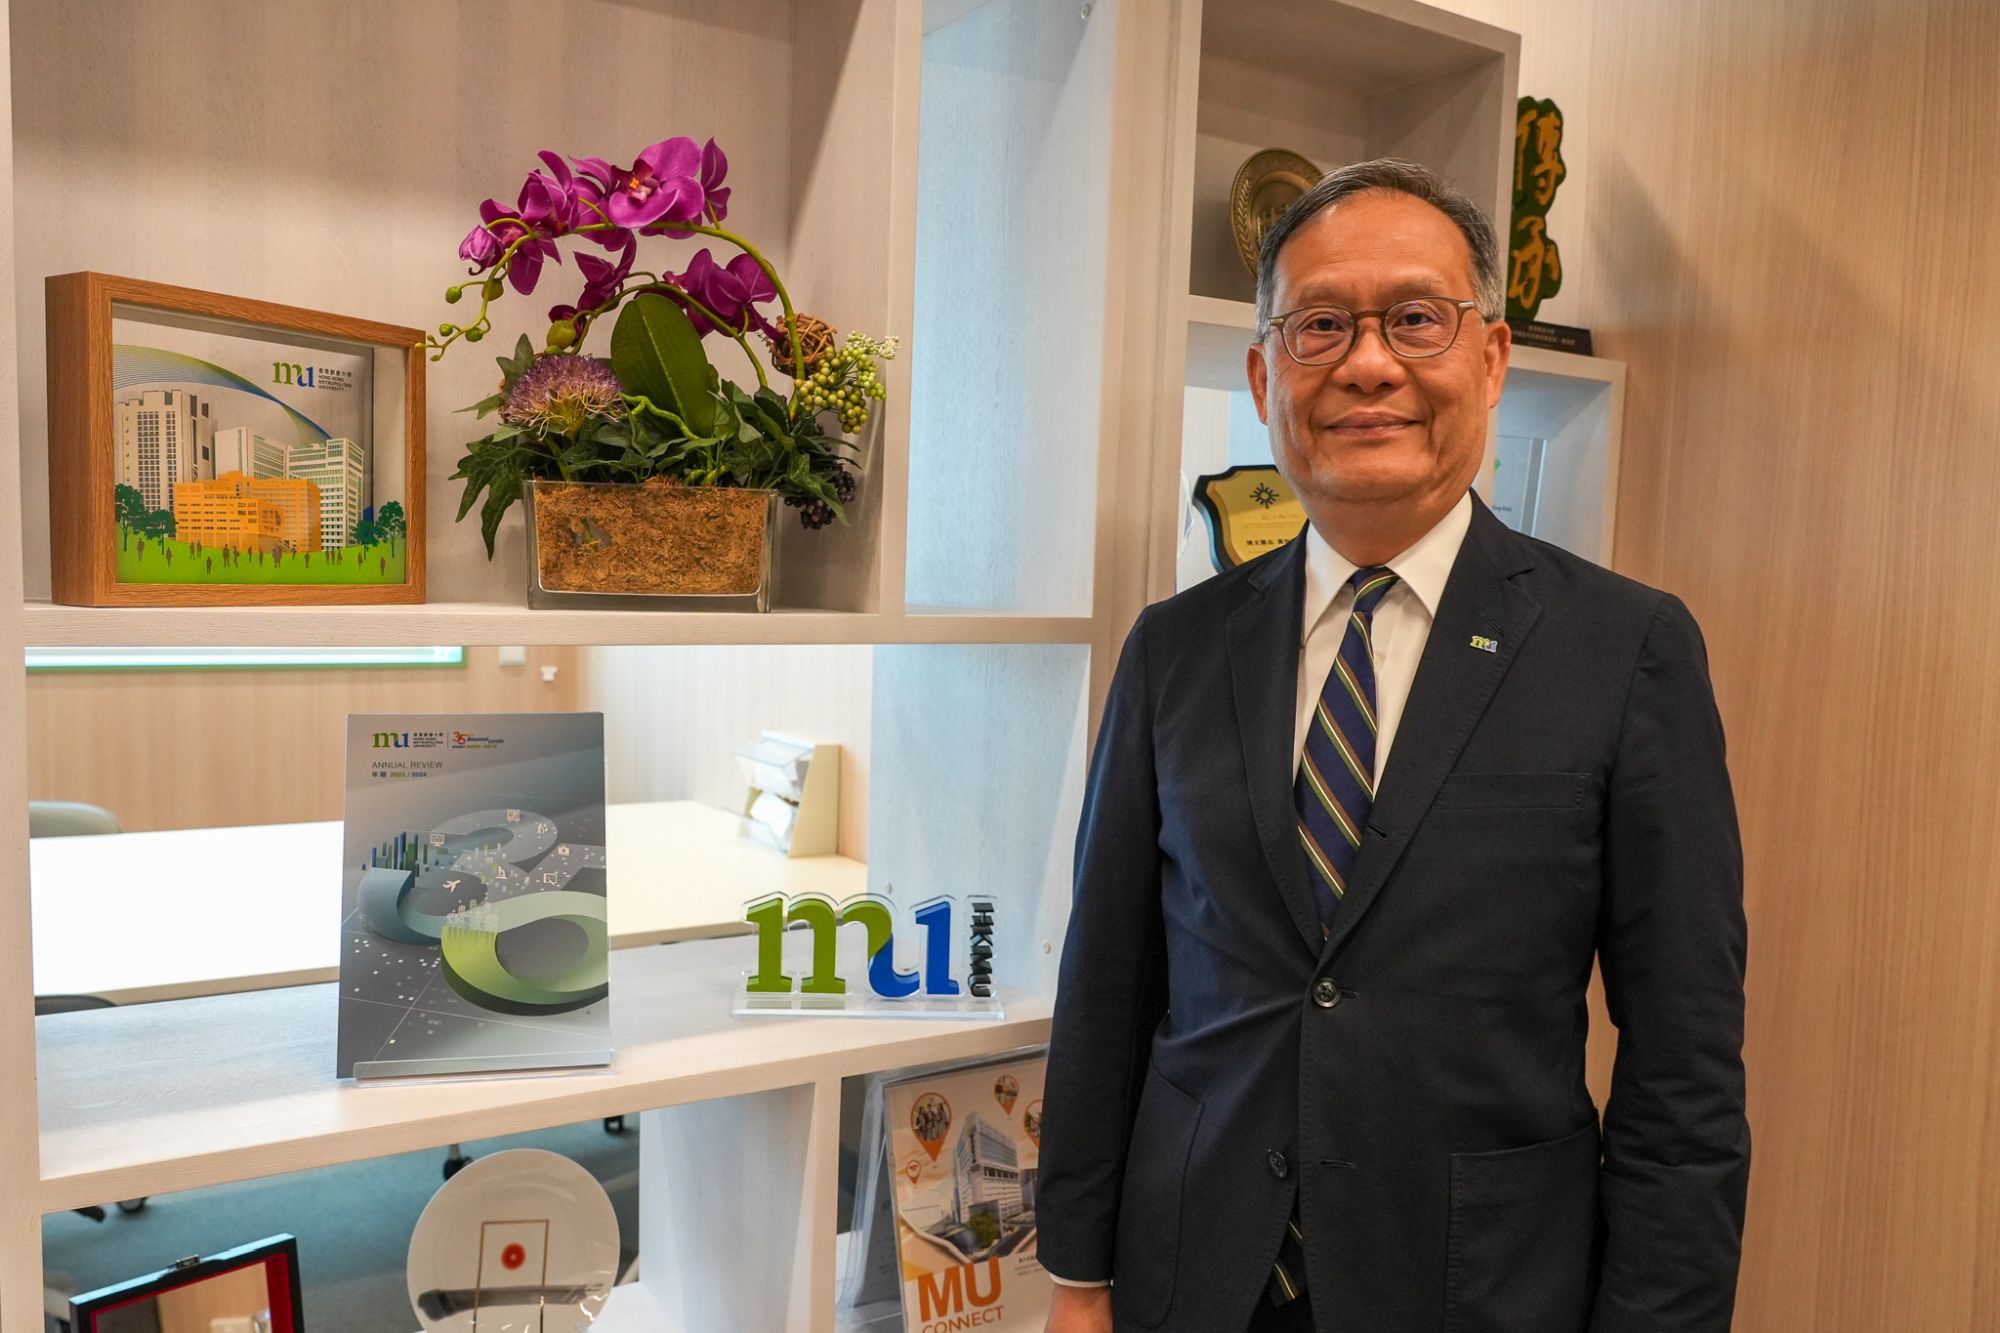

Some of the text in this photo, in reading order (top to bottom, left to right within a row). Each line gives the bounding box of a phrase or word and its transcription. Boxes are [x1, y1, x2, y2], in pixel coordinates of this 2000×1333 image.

[372, 761, 444, 769] ANNUAL REVIEW
[967, 901, 995, 998] HKMU
[917, 1256, 1002, 1323] MU
[922, 1305, 1005, 1333] CONNECT
